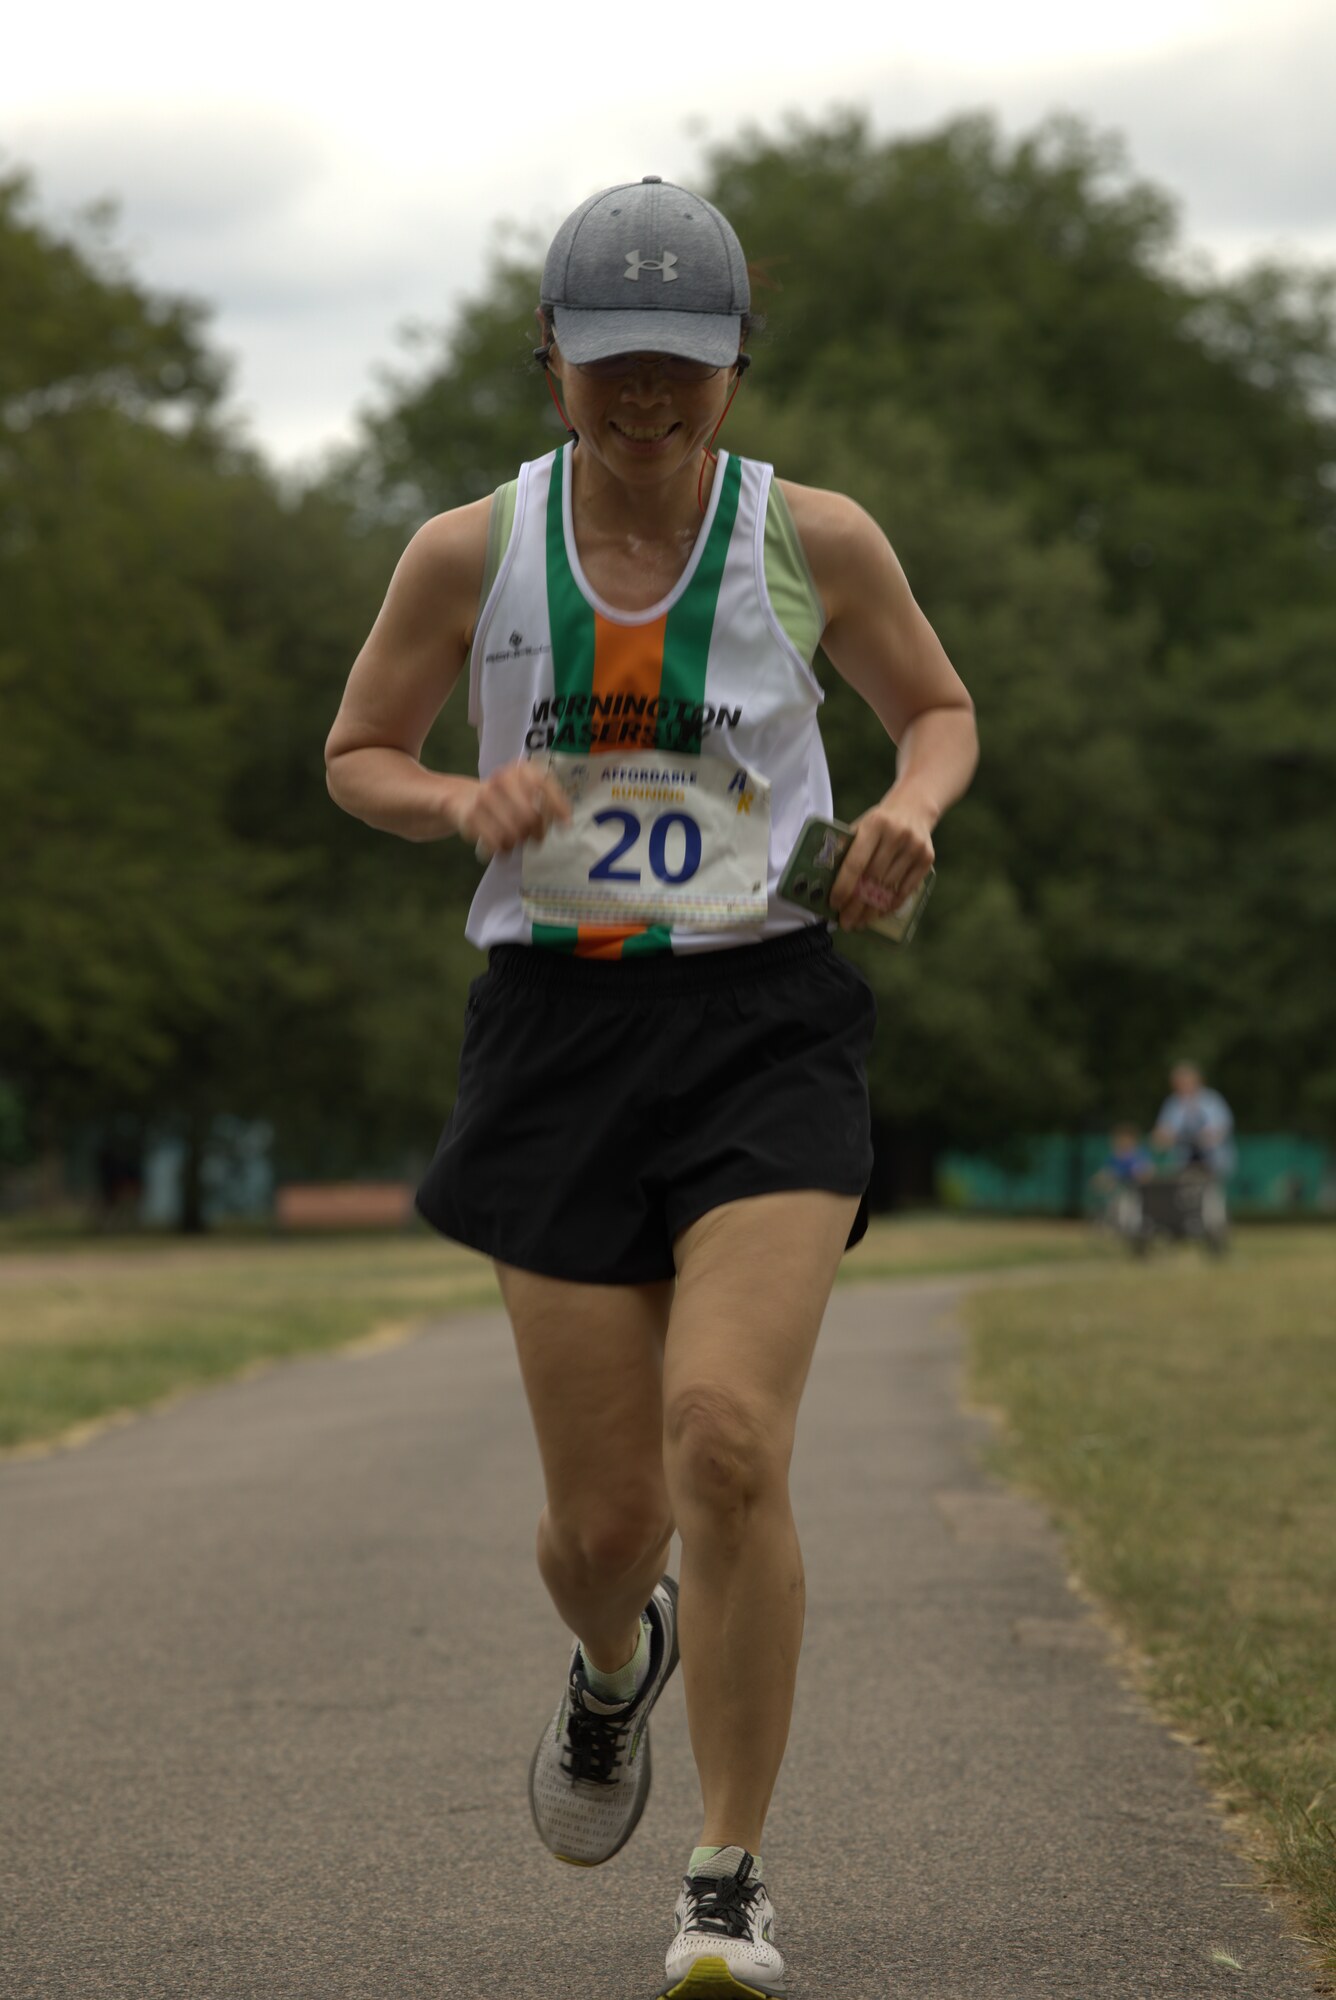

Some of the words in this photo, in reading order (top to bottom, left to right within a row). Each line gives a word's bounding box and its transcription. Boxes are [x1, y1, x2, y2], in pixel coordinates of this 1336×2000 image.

[532, 693, 742, 728] MORNINGTON
[601, 767, 697, 786] AFFORDABLE
[588, 810, 702, 885] 20
